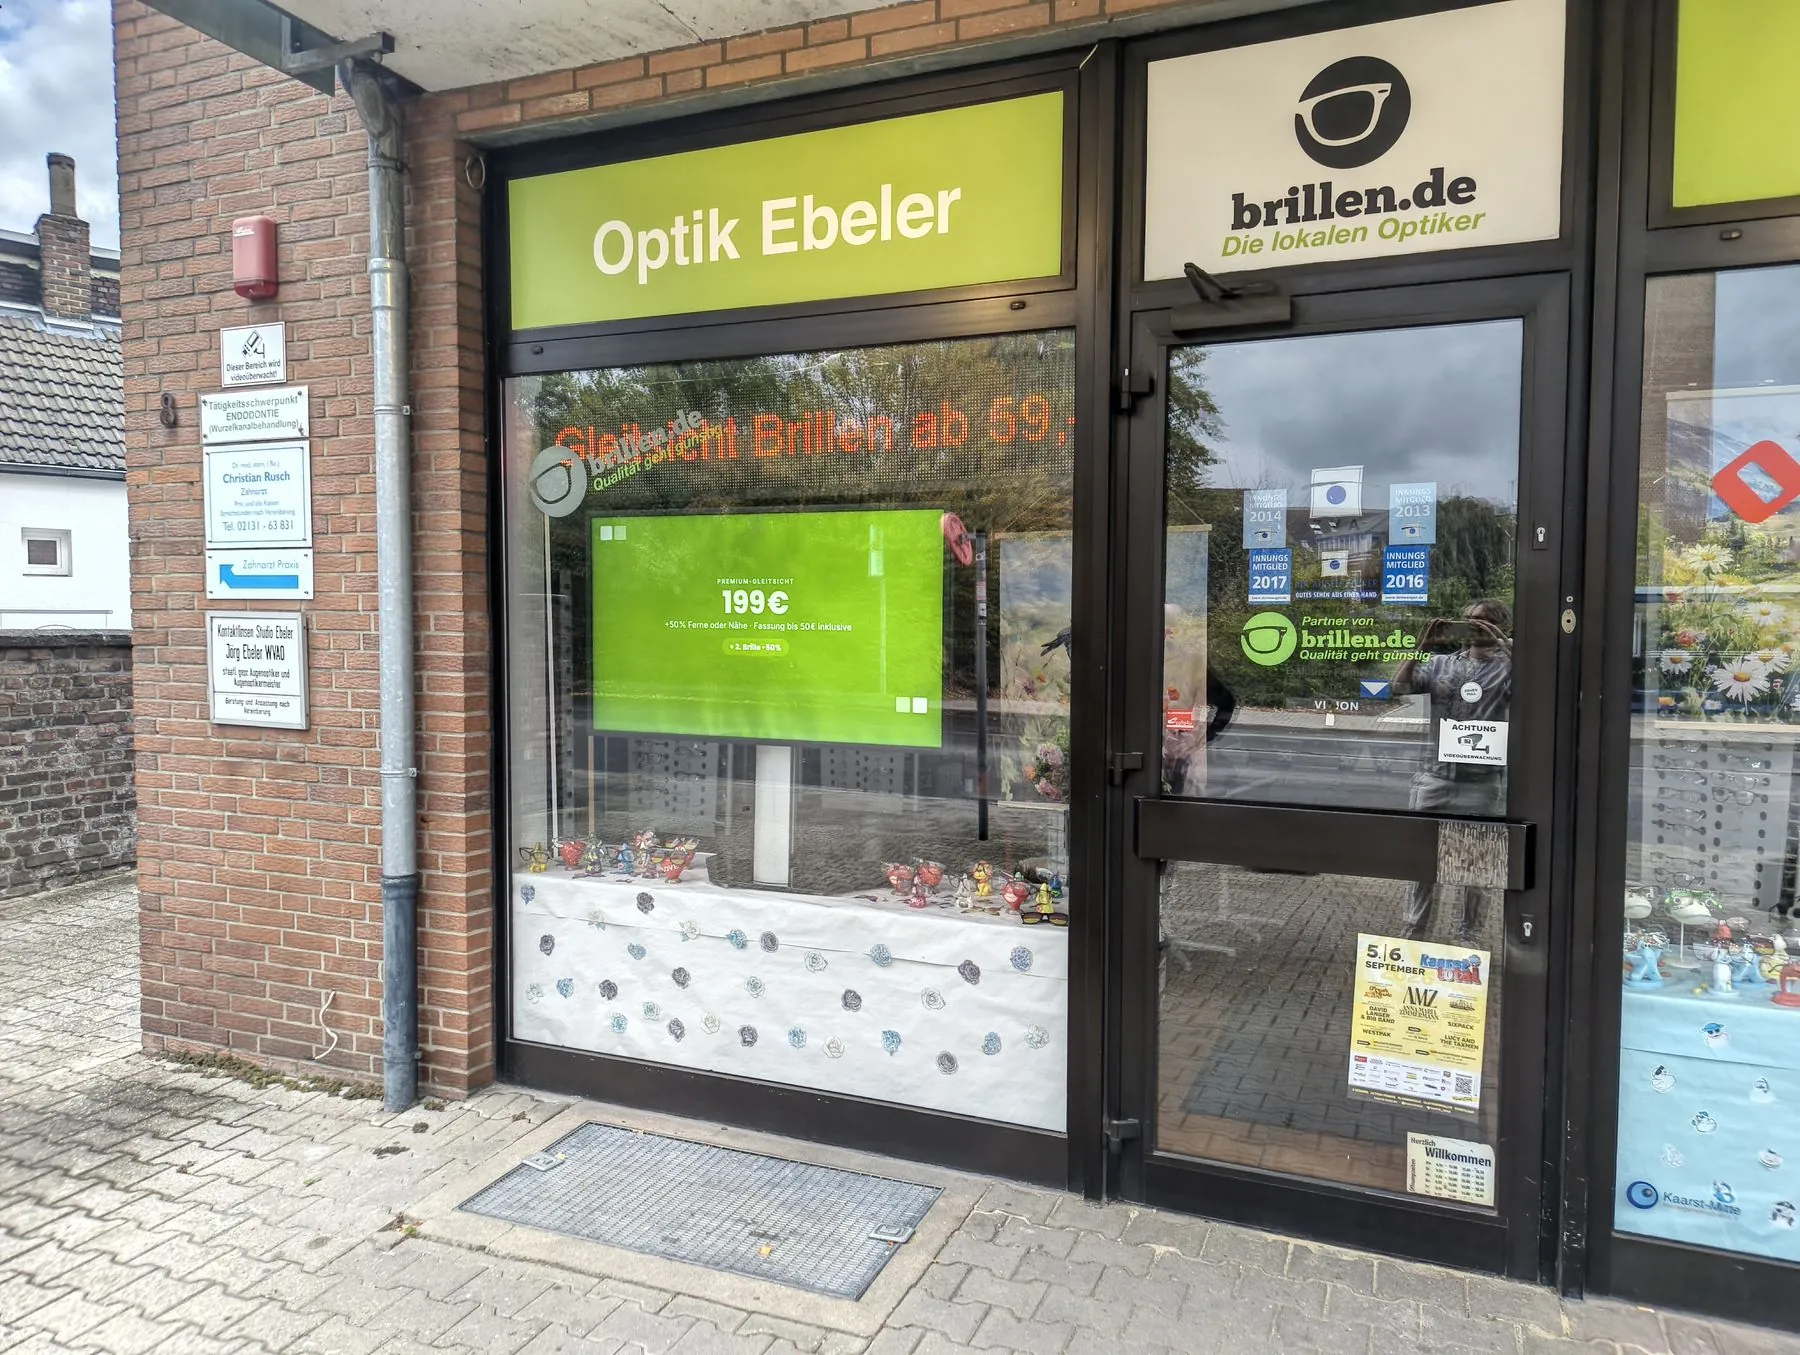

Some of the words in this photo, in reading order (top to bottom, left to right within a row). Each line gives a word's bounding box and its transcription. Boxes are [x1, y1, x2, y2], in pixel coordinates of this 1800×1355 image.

[1231, 167, 1477, 231] brillen.de
[593, 208, 740, 284] Optik
[762, 184, 961, 255] Ebeler
[1221, 235, 1263, 257] Die
[1271, 224, 1368, 252] lokalen
[1377, 211, 1486, 242] Optiker
[226, 363, 244, 371] Dieser
[245, 361, 267, 370] Bereich
[268, 359, 281, 367] wird
[231, 370, 277, 381] videoüberwacht!
[209, 395, 298, 411] Tätigkeitsschwerpunkt
[226, 409, 279, 420] ENDODONTIE
[209, 419, 299, 434] (Wurzelkanalbehandlung)
[753, 408, 893, 457] Brillen
[912, 401, 970, 449] ab
[222, 472, 261, 483] Christian
[264, 471, 290, 481] Rusch
[593, 462, 641, 491] Qualität
[240, 487, 267, 495] Zahnarzt
[1250, 510, 1281, 522] 2014
[1395, 505, 1430, 518] 2013
[222, 521, 235, 531] Tel.
[237, 521, 260, 530] 02131
[268, 520, 278, 530] 63
[280, 520, 293, 529] 831
[1253, 554, 1288, 562] INNUNGS
[1386, 552, 1425, 560] INNUNGS
[243, 560, 275, 569] Zahnarzt
[277, 560, 299, 569] Praxis
[1253, 563, 1288, 571] MITGLIED
[1386, 561, 1425, 569] MITGLIED
[1252, 575, 1287, 589] 2017
[1386, 574, 1424, 589] 2016
[722, 589, 789, 615] 199€
[688, 621, 708, 629] Ferne
[710, 621, 727, 629] oder
[728, 621, 748, 629] Nähe
[753, 621, 785, 632] Fassung
[787, 622, 798, 630] bis
[800, 622, 816, 631] 50€
[818, 622, 852, 631] inklusive
[1302, 616, 1350, 626] Partner
[1352, 618, 1374, 626] von
[218, 624, 254, 638] Kontaktlinsen
[255, 624, 273, 638] Studio
[275, 625, 293, 639] Ebeler
[1301, 629, 1415, 648] brillen.de
[226, 643, 240, 662] Jörg
[242, 643, 262, 660] Ebeler
[265, 644, 285, 661] WVAO
[1300, 650, 1348, 660] Qualität
[1351, 650, 1380, 662] geht
[1314, 700, 1359, 711] VIION
[1452, 724, 1497, 733] ACHTUNG
[1365, 960, 1426, 976] SEPTEMBER
[1448, 1021, 1474, 1030] SIXPACK
[1440, 1038, 1452, 1046] THE
[1454, 1041, 1479, 1050] TAXMEN
[1445, 1034, 1461, 1042] LUCY
[1410, 1137, 1436, 1147] Herzlich
[1425, 1146, 1492, 1168] Willkommen
